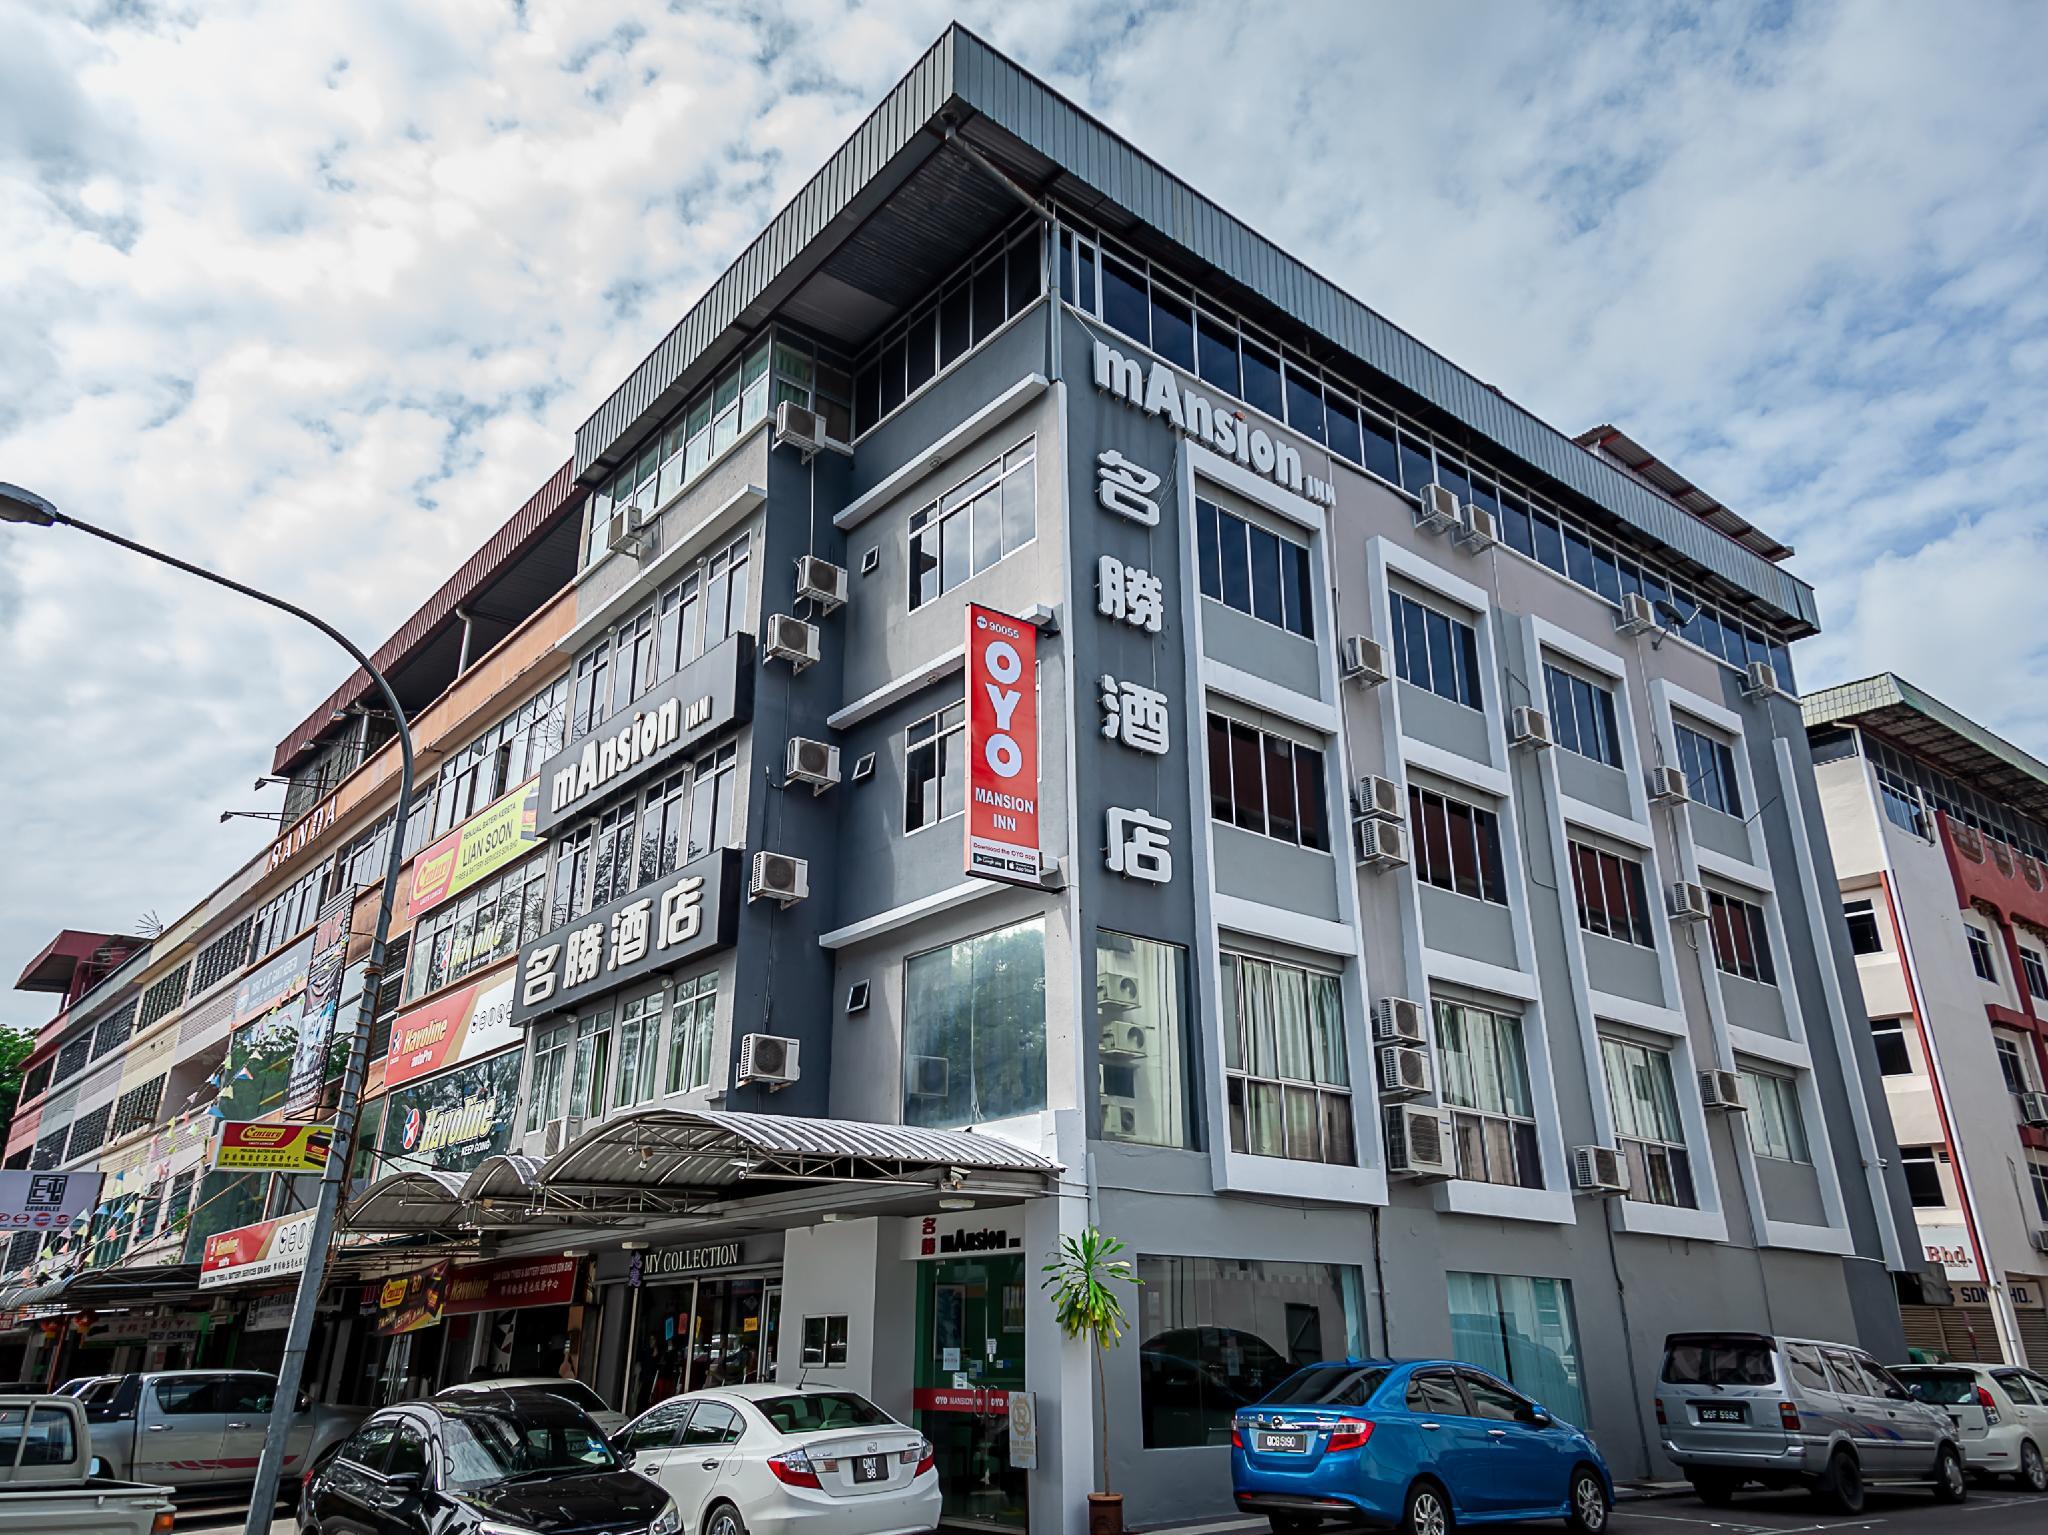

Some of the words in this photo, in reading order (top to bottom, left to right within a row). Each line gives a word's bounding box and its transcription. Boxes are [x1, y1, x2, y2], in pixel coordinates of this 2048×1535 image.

[989, 622, 1020, 639] 90055
[1097, 449, 1173, 883] 名勝酒店
[685, 695, 712, 731] INN
[985, 640, 1023, 778] OYO
[975, 787, 1034, 814] MANSION
[993, 813, 1017, 832] INN
[462, 838, 484, 867] LIAN
[485, 819, 514, 854] SOON
[973, 842, 1001, 853] Download
[523, 876, 703, 1006] 名勝酒店
[402, 1017, 448, 1056] Havoline
[418, 1094, 496, 1155] Havoline
[461, 1144, 474, 1157] KEEP
[644, 1249, 663, 1274] MY
[663, 1243, 739, 1272] COLLECTION
[1925, 1245, 1973, 1264] Bhd.
[866, 1467, 877, 1480] 98
